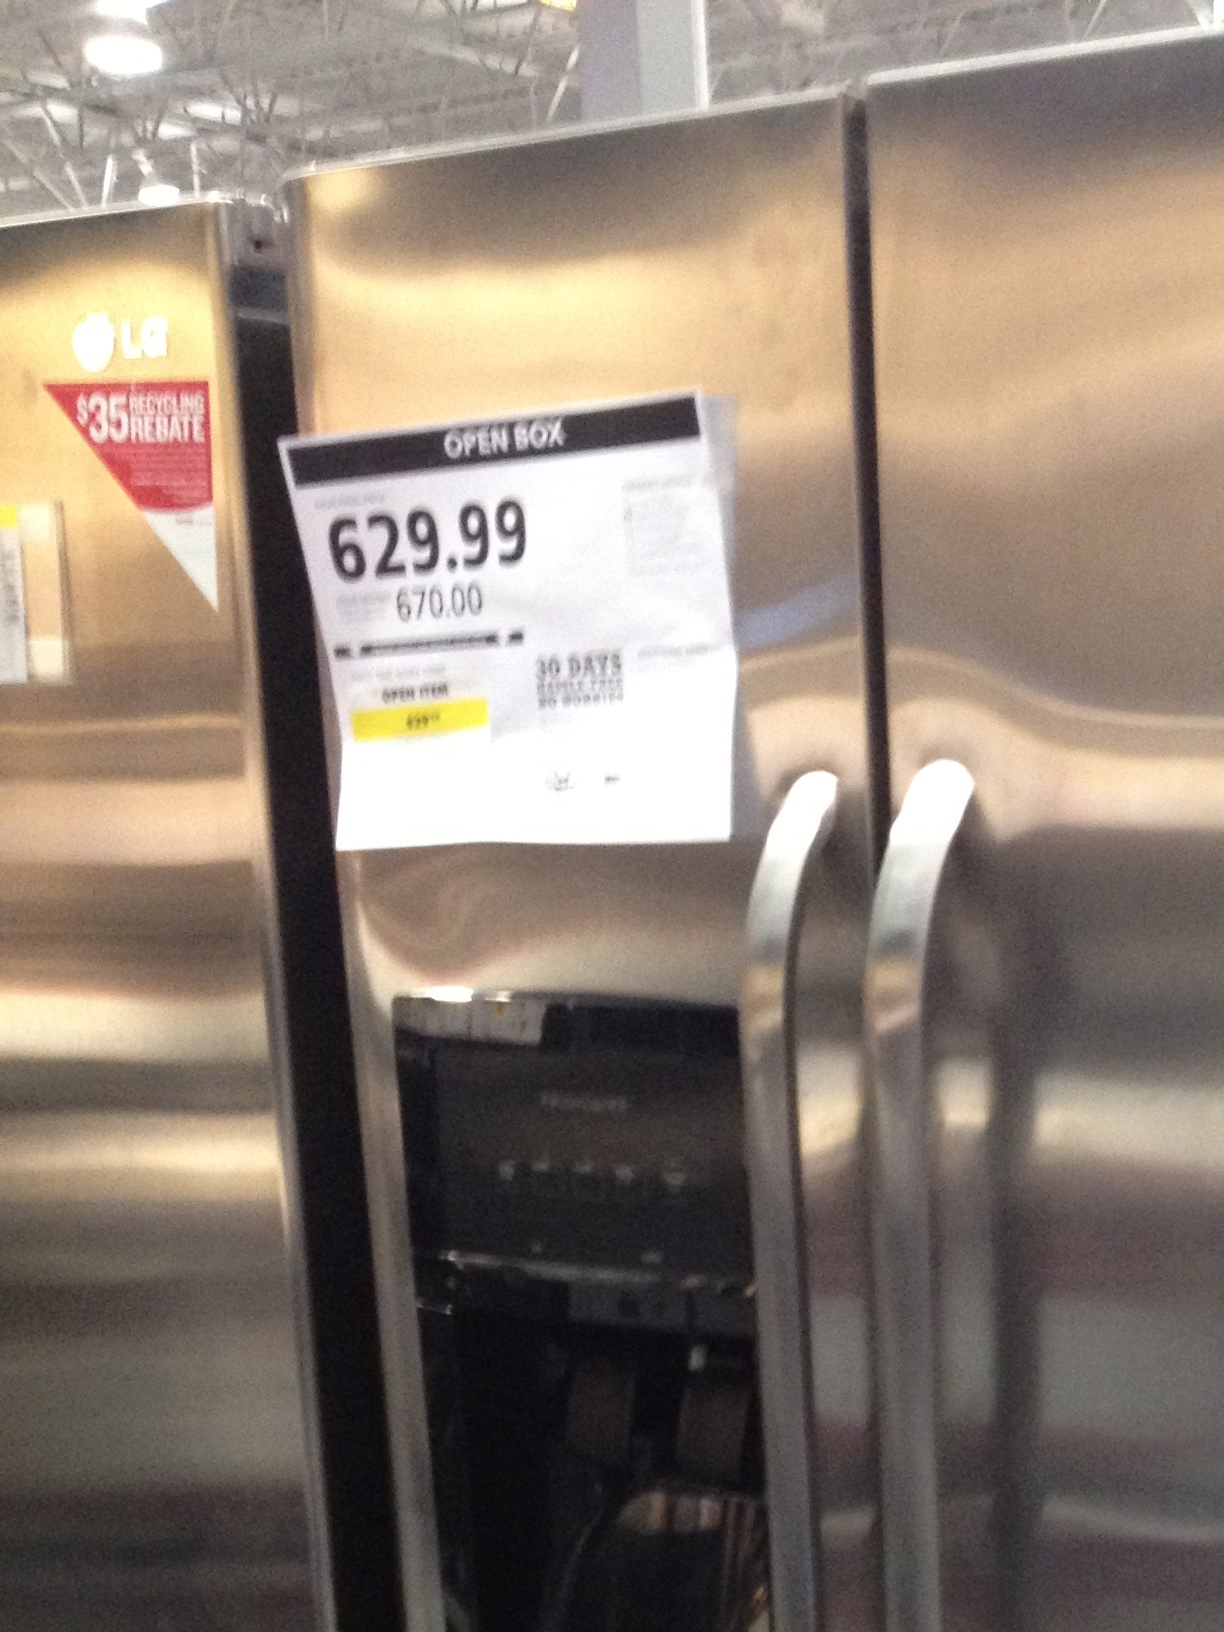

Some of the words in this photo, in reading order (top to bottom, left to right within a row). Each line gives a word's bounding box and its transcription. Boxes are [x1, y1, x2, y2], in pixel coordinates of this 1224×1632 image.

[120, 316, 168, 359] LG
[76, 391, 129, 443] $35
[130, 392, 205, 415] RECYCLING
[130, 415, 205, 443] REBATE
[443, 428, 508, 459] OPEN
[515, 420, 566, 451] BOX
[327, 495, 528, 583] 629.99
[395, 580, 485, 622] 670.00
[568, 651, 622, 677] DAYS
